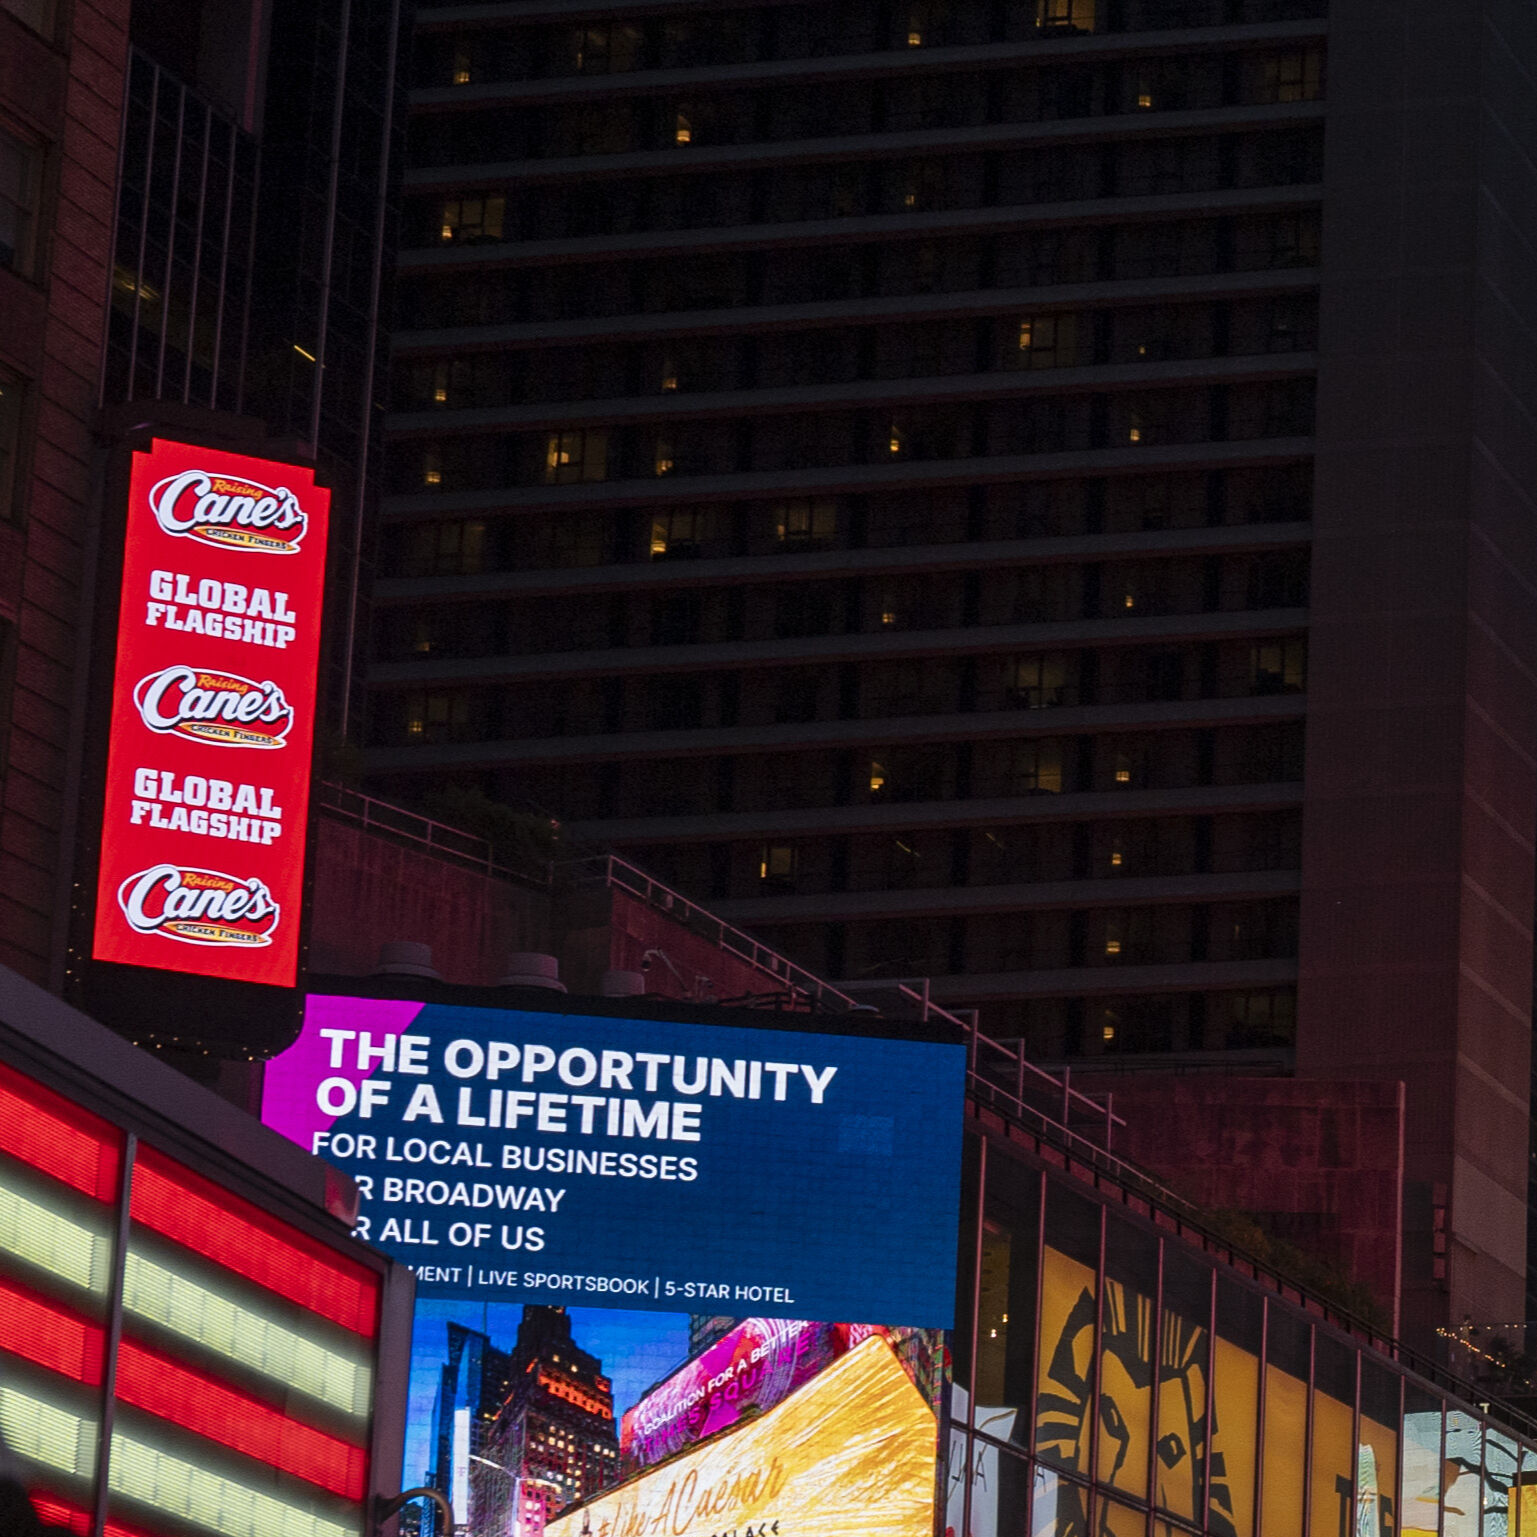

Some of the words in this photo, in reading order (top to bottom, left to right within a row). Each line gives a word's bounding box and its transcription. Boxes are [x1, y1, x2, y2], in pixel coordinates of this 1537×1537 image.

[158, 472, 302, 529] Cane's
[212, 479, 263, 500] Raising
[150, 569, 296, 623] GLOBAL
[145, 601, 296, 649] FLAGSHIP
[143, 667, 288, 727] Cane's
[197, 675, 248, 695] Raising
[134, 767, 282, 819] GLOBAL
[130, 799, 282, 845] FLAGSHIP
[128, 866, 274, 928] Cane's
[182, 872, 234, 893] Raising
[320, 1028, 431, 1075] THE
[443, 1038, 838, 1104] OPPORTUNITY
[316, 1076, 392, 1118] OF
[402, 1083, 444, 1124] A
[457, 1086, 702, 1142] LIFETIME
[312, 1131, 377, 1160] FOR
[385, 1136, 493, 1168] LOCAL
[502, 1144, 698, 1182] BUSINESSES
[383, 1177, 566, 1213] BROADWAY
[379, 1217, 439, 1245] ALL
[448, 1222, 492, 1248] OF
[501, 1225, 545, 1251] US
[478, 1270, 517, 1286] LIVE
[523, 1272, 649, 1295] SPORTSBOOK
[665, 1281, 730, 1299] 5-STAR
[735, 1286, 795, 1303] HOTEL
[644, 1386, 705, 1435] COALITION
[708, 1367, 734, 1393] FOR
[737, 1358, 748, 1374] A
[751, 1320, 809, 1364] BETTER
